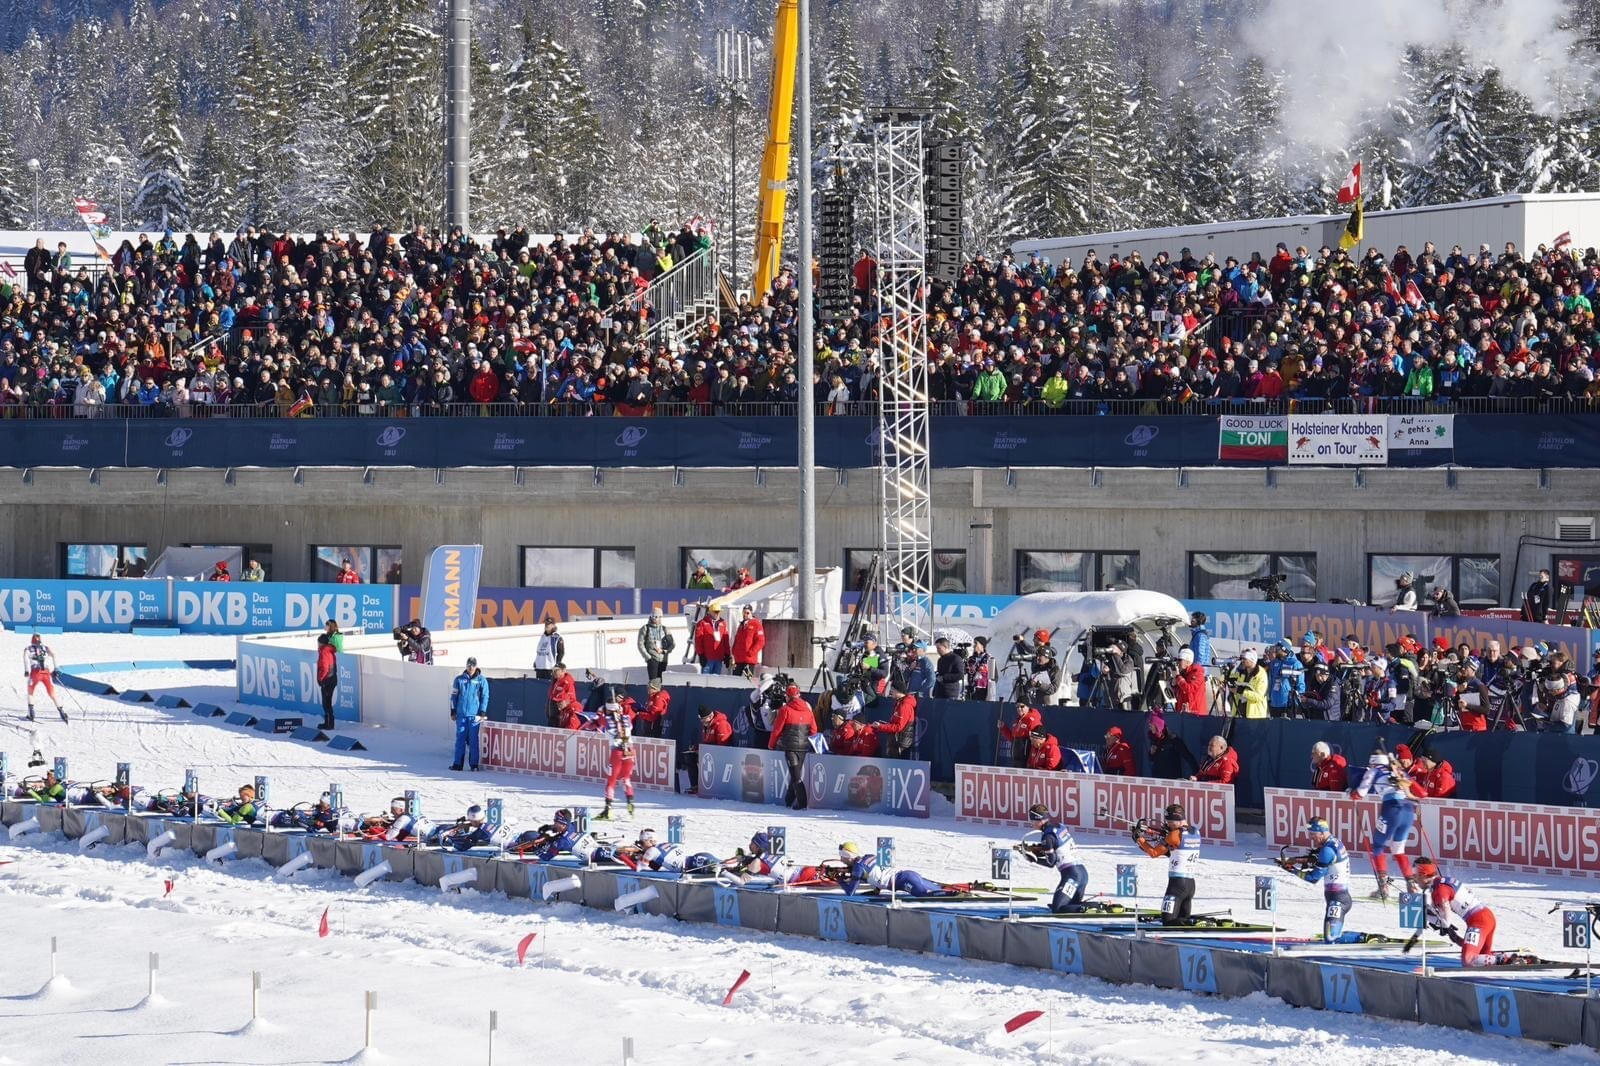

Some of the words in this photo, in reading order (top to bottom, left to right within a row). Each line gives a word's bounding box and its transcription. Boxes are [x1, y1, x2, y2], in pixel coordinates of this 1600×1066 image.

[1226, 419, 1254, 429] GOOD
[1259, 419, 1283, 429] LUCK
[1291, 422, 1338, 436] Holsteiner
[1341, 422, 1383, 436] Krabben
[1401, 417, 1414, 425] Auf
[1237, 431, 1272, 446] TONI
[1409, 438, 1429, 446] Anna
[1318, 444, 1332, 454] on
[1334, 442, 1357, 455] Tour
[36, 590, 51, 600] Das
[139, 591, 155, 601] Das
[253, 593, 268, 603] Das
[362, 595, 380, 605] Das
[36, 604, 55, 612] kann
[67, 590, 135, 624] DKB
[139, 604, 159, 613] kann
[178, 591, 248, 626] DKB
[252, 605, 272, 615] kann
[285, 593, 357, 628] DKB
[362, 608, 384, 617] kann
[36, 614, 55, 623] Bank
[252, 618, 272, 627] Bank
[362, 619, 384, 630] Bank
[1215, 611, 1261, 642] DKB
[242, 654, 279, 699] DKB
[481, 732, 565, 768] BAUHAUS
[57, 765, 64, 778] 3
[120, 771, 127, 785] 4
[258, 785, 265, 800] 6
[892, 767, 926, 811] iX2
[964, 778, 1078, 818] BAUHAUS
[491, 807, 498, 824] 9
[576, 816, 588, 833] 10
[669, 826, 682, 843] 11
[1442, 814, 1598, 862] BAUHAUS
[768, 836, 785, 855] 12
[878, 847, 892, 867] 13
[993, 859, 1010, 880] 14
[1118, 875, 1136, 897] 15
[720, 894, 735, 920] 12
[1256, 889, 1272, 909] 16
[823, 906, 839, 932] 13
[1329, 906, 1338, 916] 52
[1400, 906, 1423, 928] 17
[936, 919, 953, 949] 14
[1565, 924, 1588, 947] 18
[1056, 936, 1075, 967] 15
[1187, 953, 1208, 985] 16
[1330, 973, 1351, 1004] 17
[1485, 994, 1510, 1028] 18
